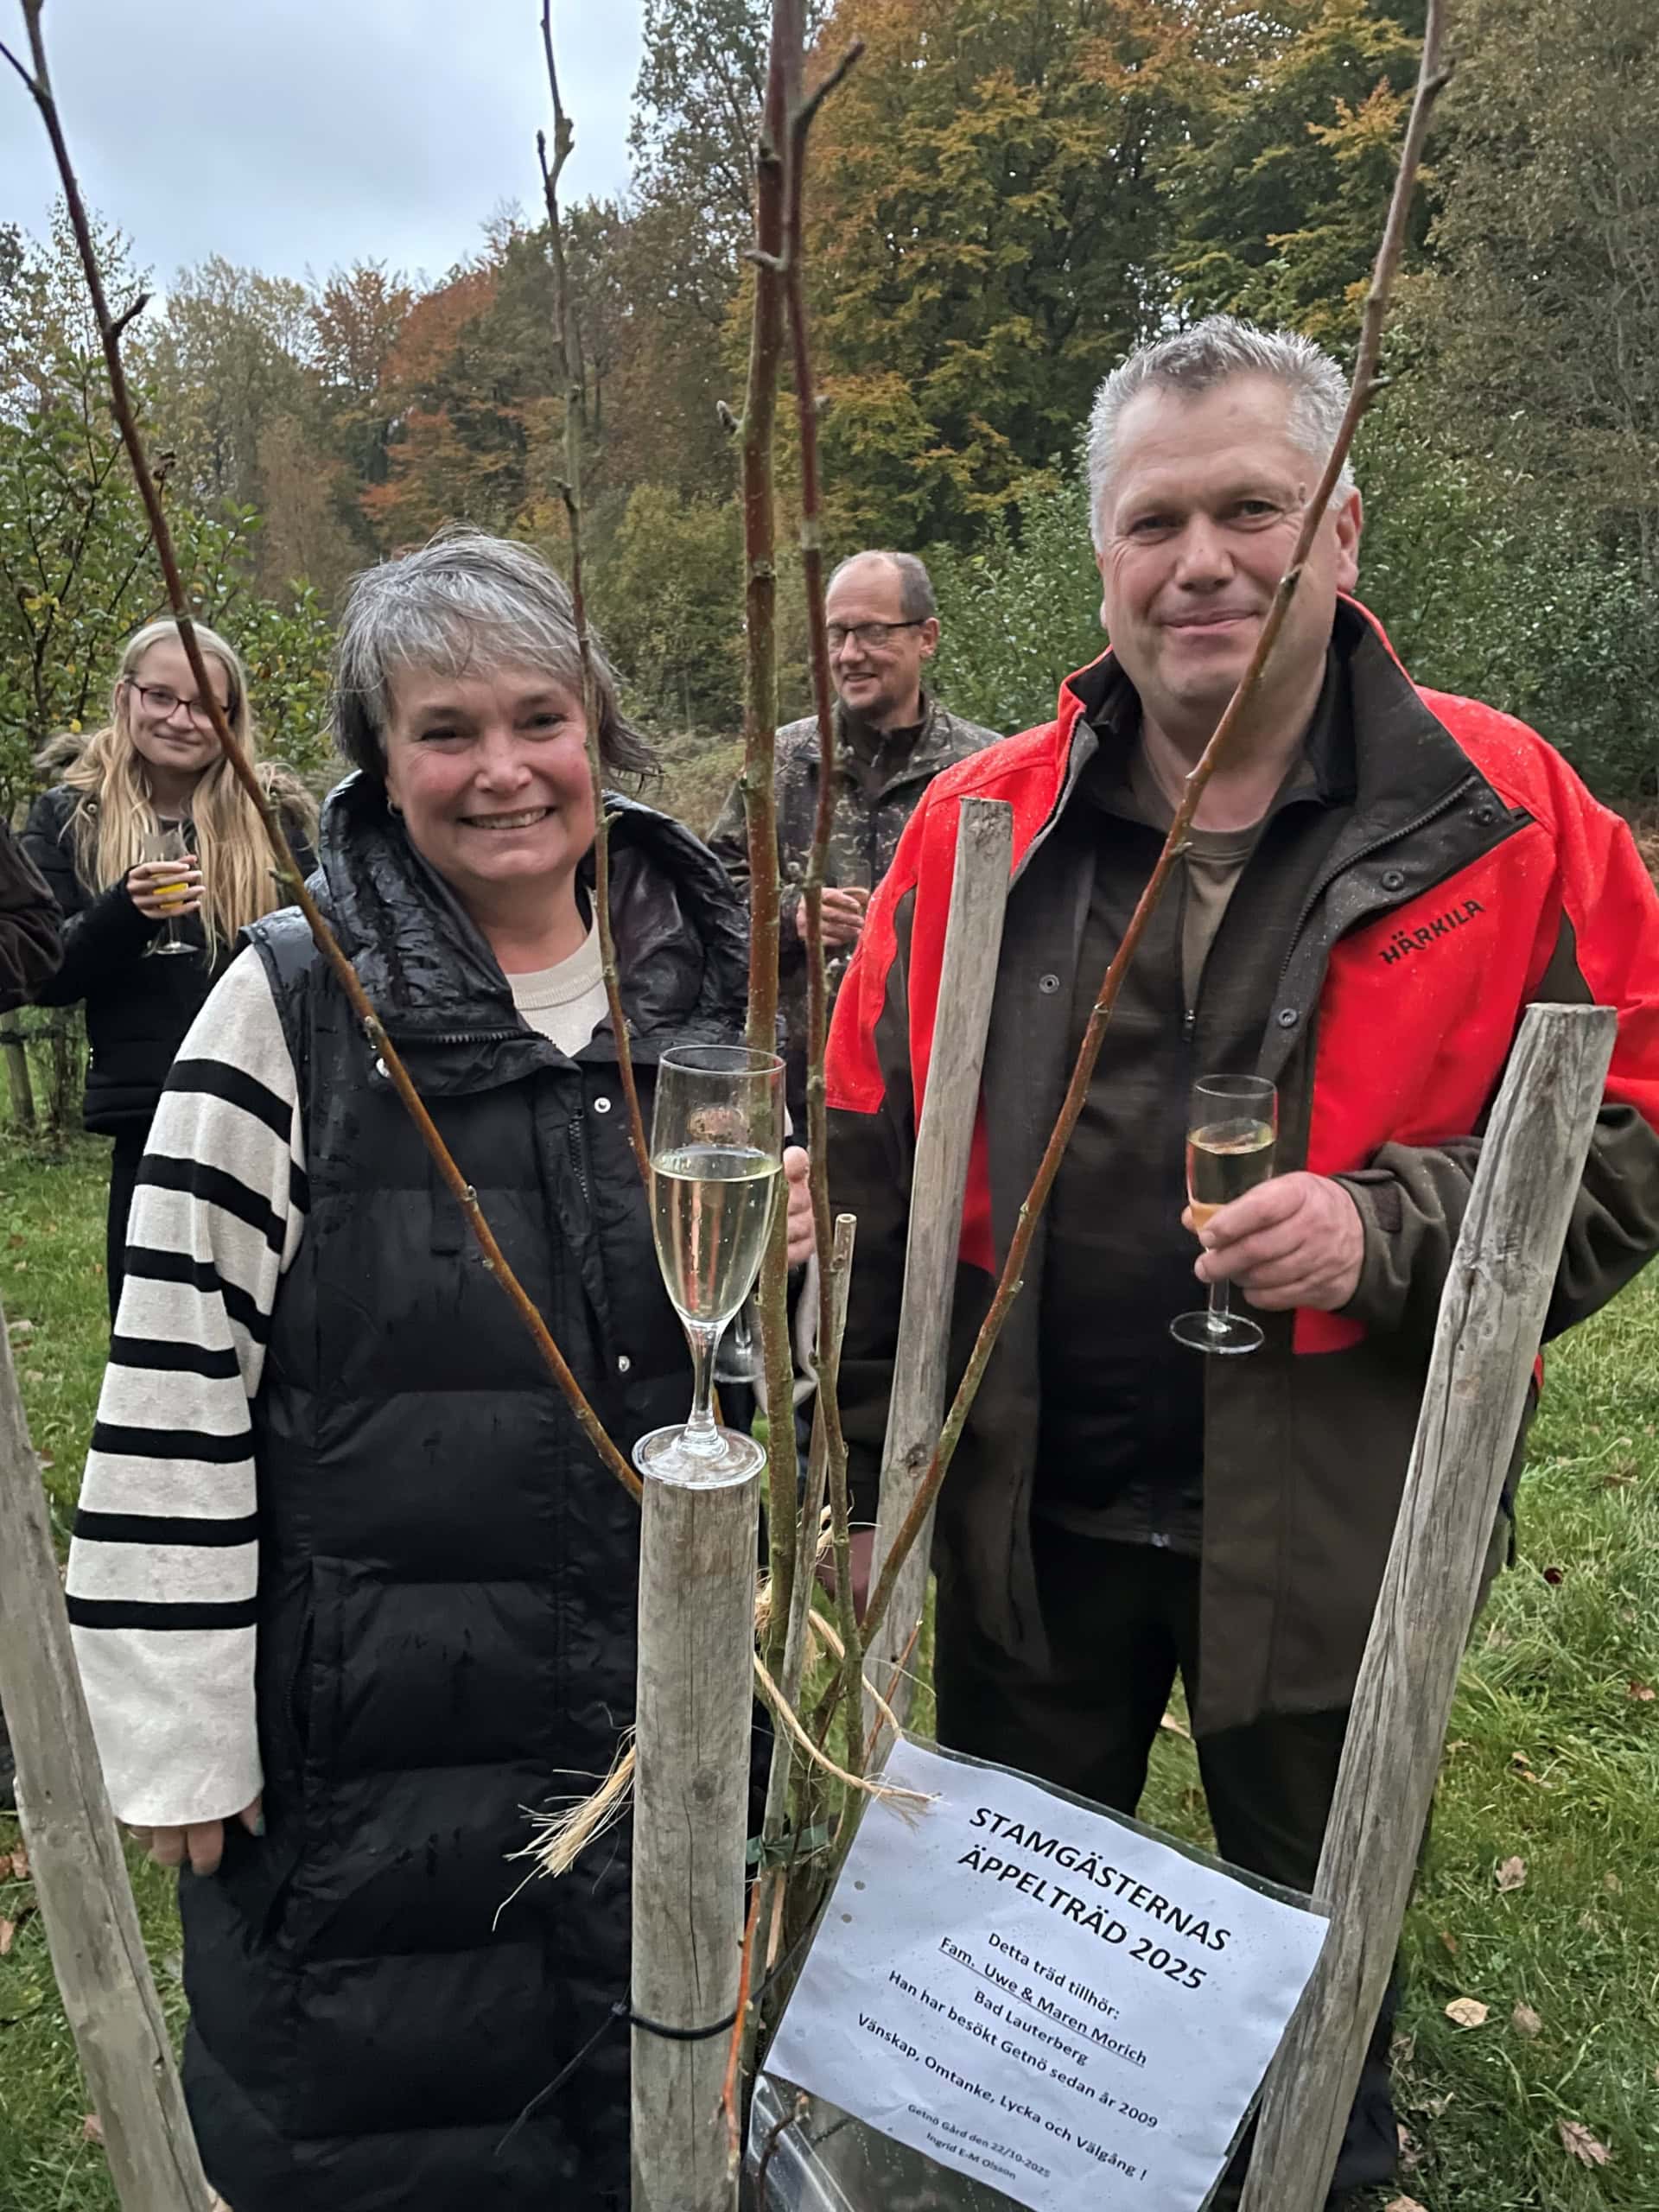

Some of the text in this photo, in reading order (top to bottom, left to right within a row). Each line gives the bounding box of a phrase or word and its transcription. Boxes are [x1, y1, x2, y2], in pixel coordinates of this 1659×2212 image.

[1379, 899, 1485, 964] HÄRKILA
[958, 1844, 1207, 1989] ÄPPELTRÄD 2025
[969, 1808, 1231, 1951] STAMGÄSTERNAS
[940, 1936, 1147, 2066] Fam. Uwe & Maren Morich
[974, 1991, 1089, 2067] Bad Lauterberg
[988, 1933, 1120, 2020] Detta träd tillhör:
[858, 2013, 920, 2063] Vänskap,
[925, 2056, 995, 2104] Omtanke,
[1000, 2094, 1041, 2124] Lycka
[1045, 2120, 1072, 2142] och
[1077, 2136, 1136, 2178] Välgång
[888, 1970, 1159, 2129] Han har besökt Getnö sedan år 2009
[907, 2103, 939, 2126] Getnö
[941, 2121, 969, 2139] Gård
[969, 2134, 988, 2148] den
[926, 2132, 957, 2153] Ingrid
[982, 2158, 1016, 2180] Olsson
